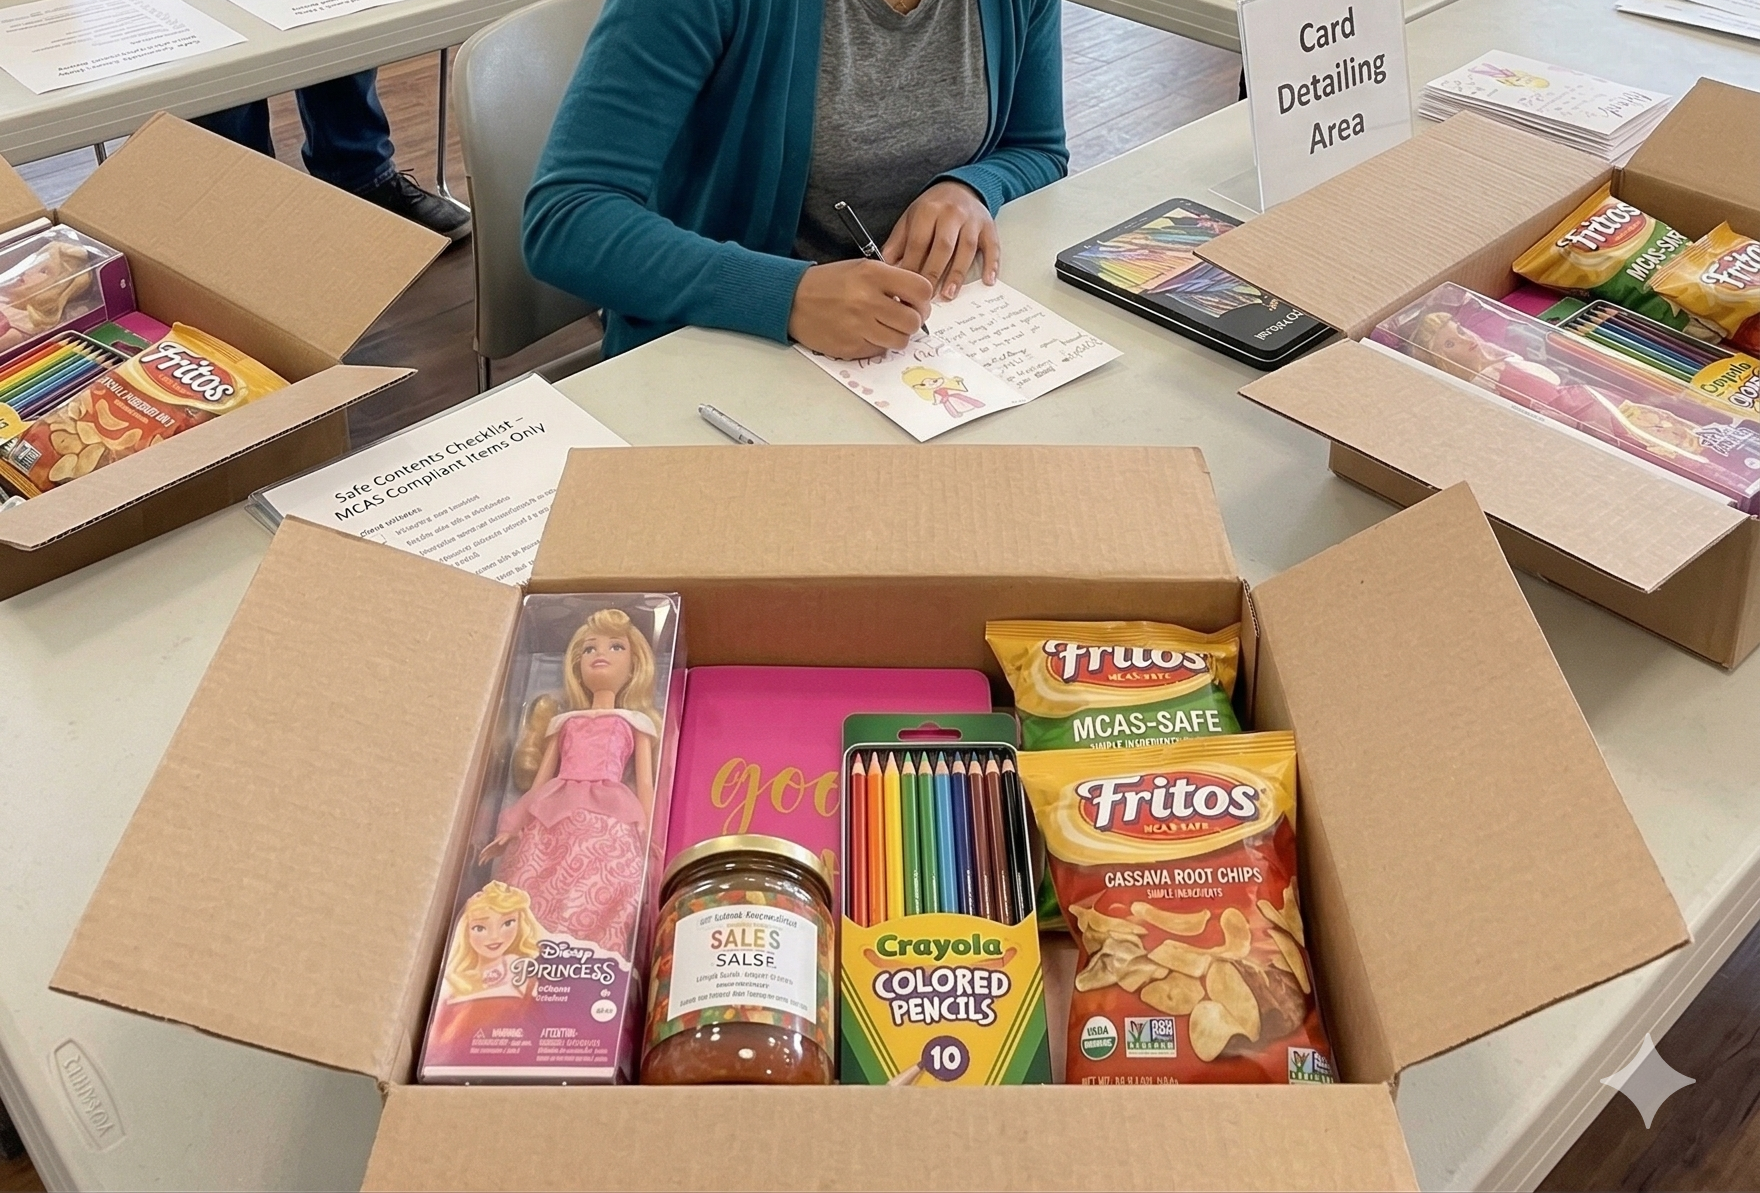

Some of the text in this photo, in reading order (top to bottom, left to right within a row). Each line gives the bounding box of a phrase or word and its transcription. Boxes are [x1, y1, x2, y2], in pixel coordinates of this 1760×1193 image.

[1300, 6, 1356, 53] Card
[1277, 54, 1387, 115] Detailing
[1309, 112, 1365, 155] Area
[1556, 202, 1641, 251] Fritos
[140, 341, 235, 402] Fritos
[334, 484, 372, 504] Safe
[373, 450, 445, 487] Contents
[445, 420, 514, 455] Checklist
[334, 494, 385, 522] MCAS
[386, 459, 467, 500] Compliant
[510, 422, 546, 444] Only
[1044, 639, 1207, 680] Fritos
[1073, 710, 1222, 742] MCAS-SAFE
[1078, 775, 1258, 828] Fritos
[1105, 867, 1263, 887] CASSAVA ROOT CHIPS
[711, 928, 781, 950] SALES
[876, 933, 1003, 961] Crayola
[510, 957, 616, 985] PRINCESS
[716, 953, 775, 968] SALSE
[874, 966, 1010, 1000] COLORED
[890, 995, 996, 1026] PENCILS
[930, 1045, 962, 1071] 10
